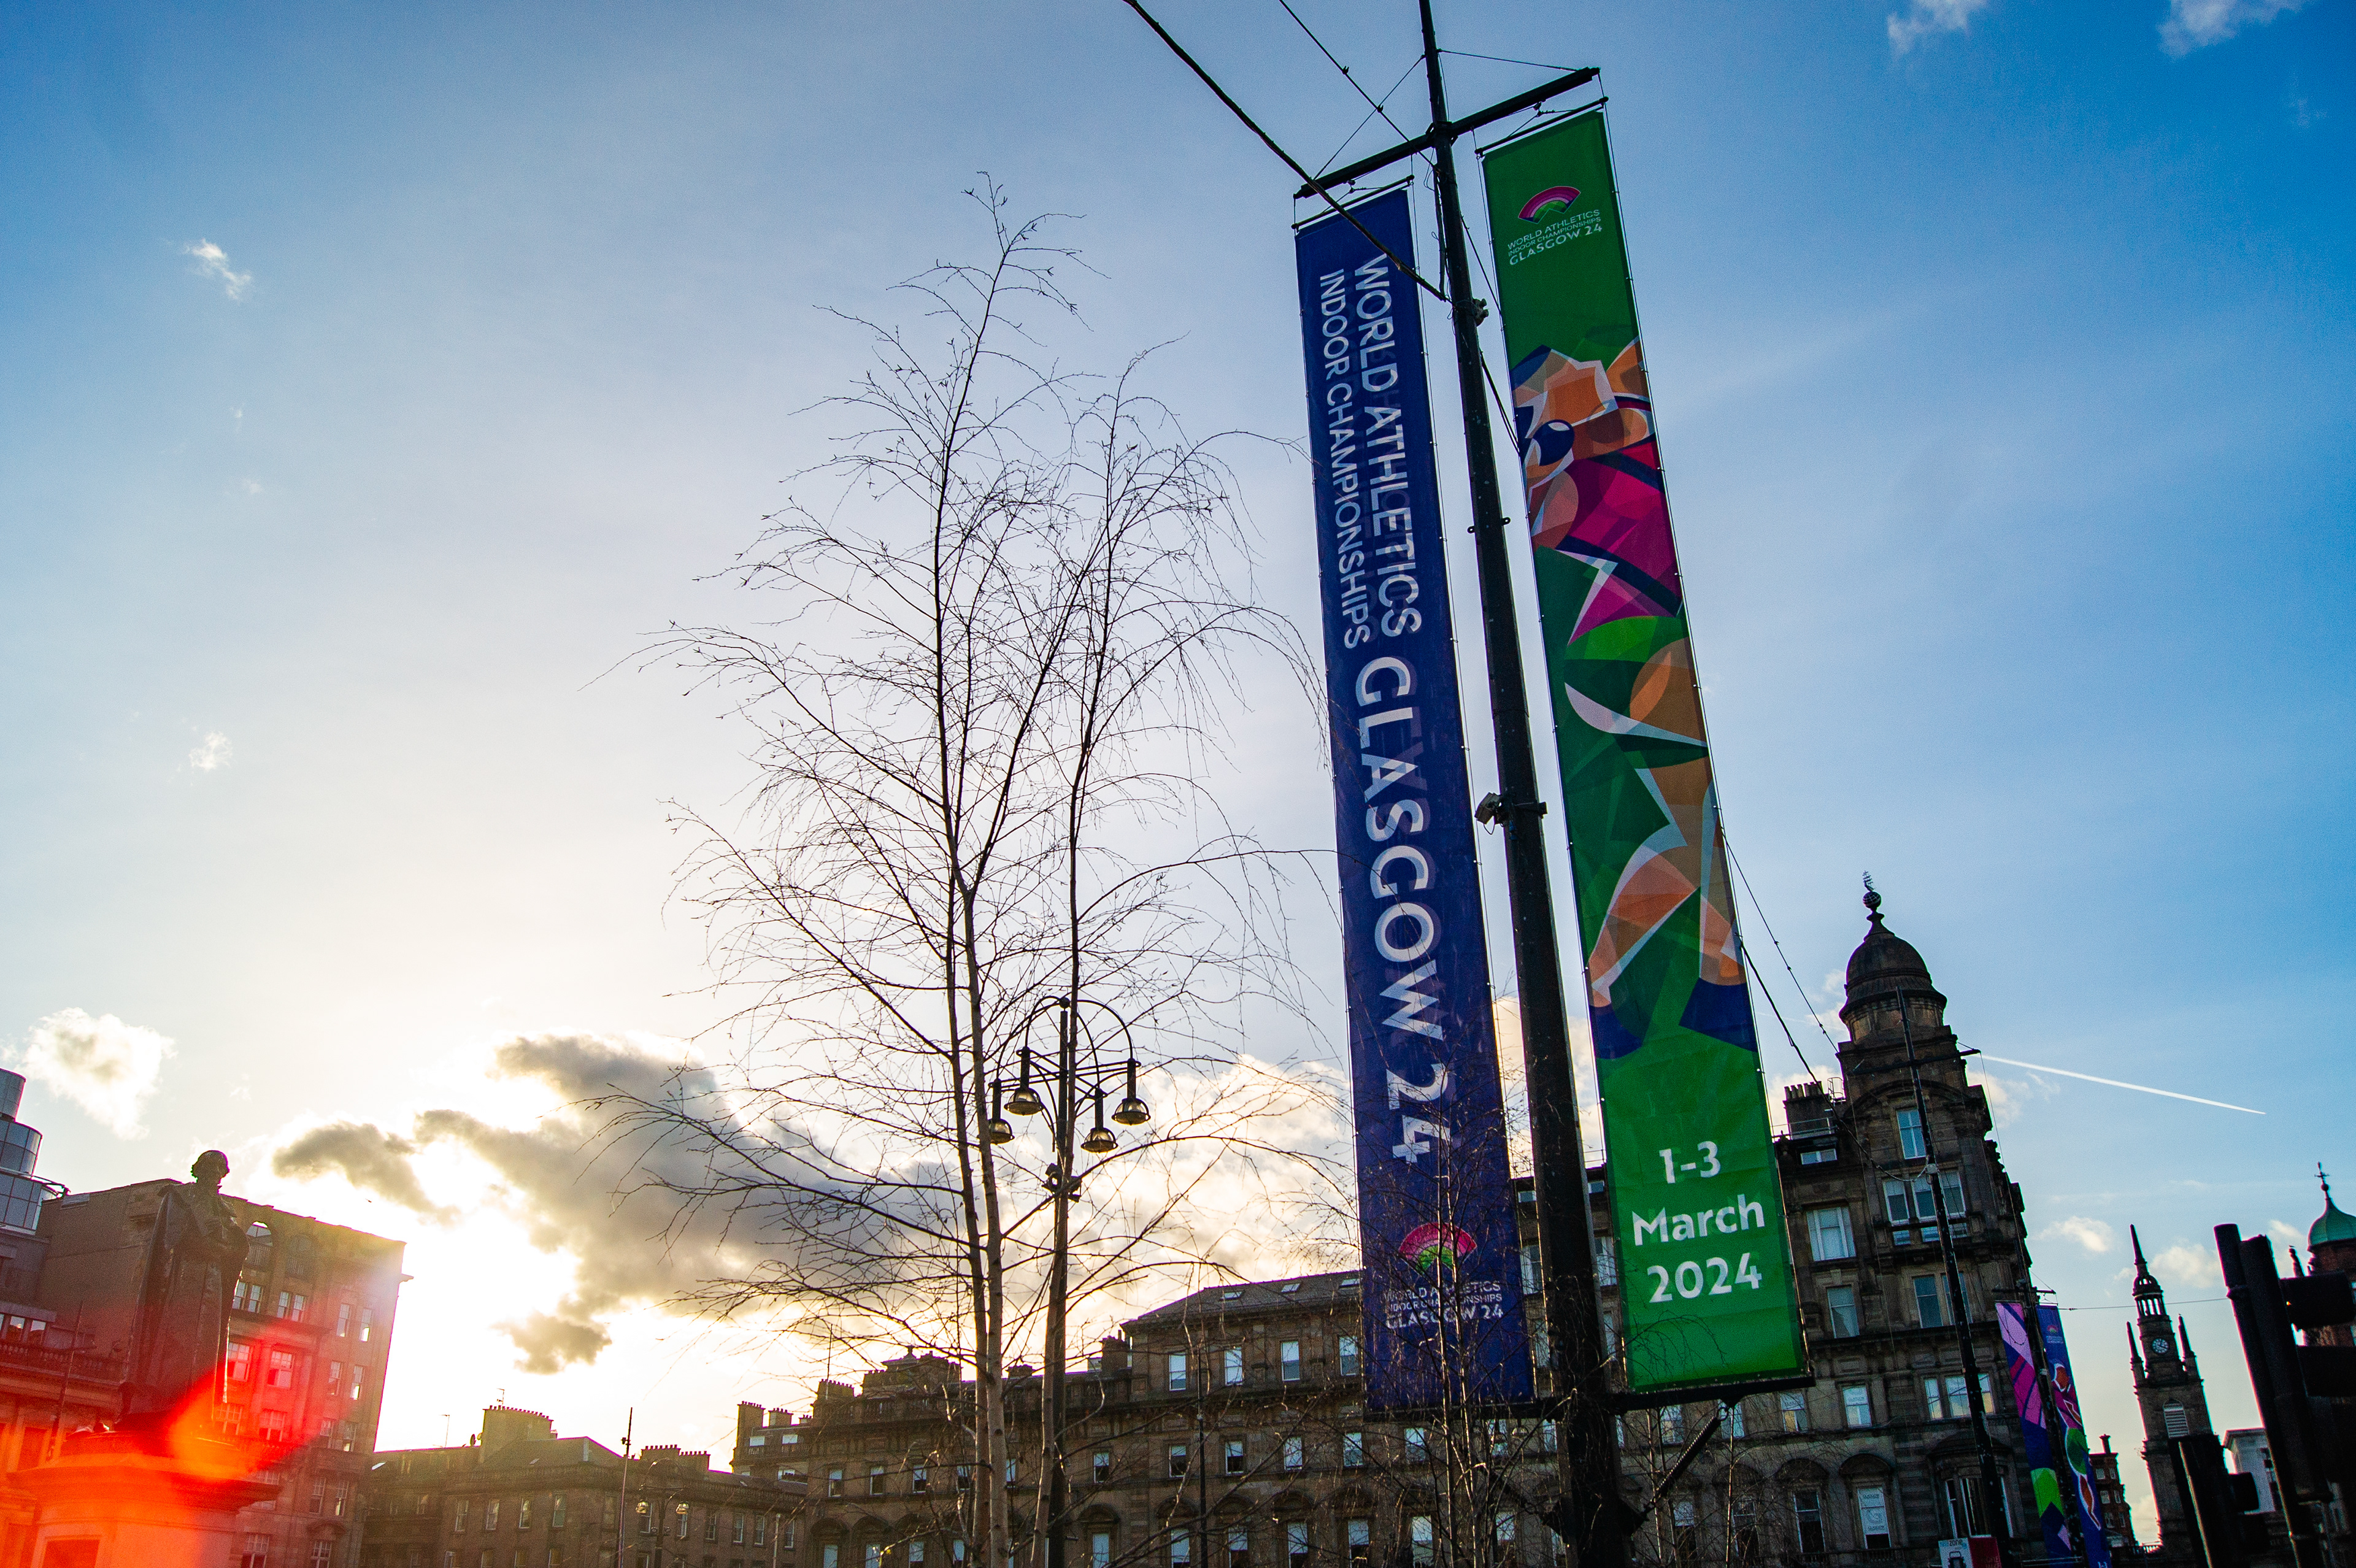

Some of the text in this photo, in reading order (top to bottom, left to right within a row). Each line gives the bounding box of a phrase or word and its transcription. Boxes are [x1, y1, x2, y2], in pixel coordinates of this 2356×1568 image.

[1507, 209, 1600, 250] WORLD ATHLETICS
[1508, 217, 1601, 256] INDOOR CHAMPIONSHIPS
[1509, 223, 1603, 265] GLASGOW 24
[1320, 269, 1371, 649] INDOOR CHAMPIONSHIPS
[1355, 254, 1422, 637] WORLD ATHLETICS
[1356, 657, 1452, 1164] GLASGOW 24
[1659, 1141, 1722, 1184] 1-3
[1632, 1194, 1765, 1247] March
[1647, 1252, 1762, 1304] 2024
[1481, 1303, 1503, 1320] 24
